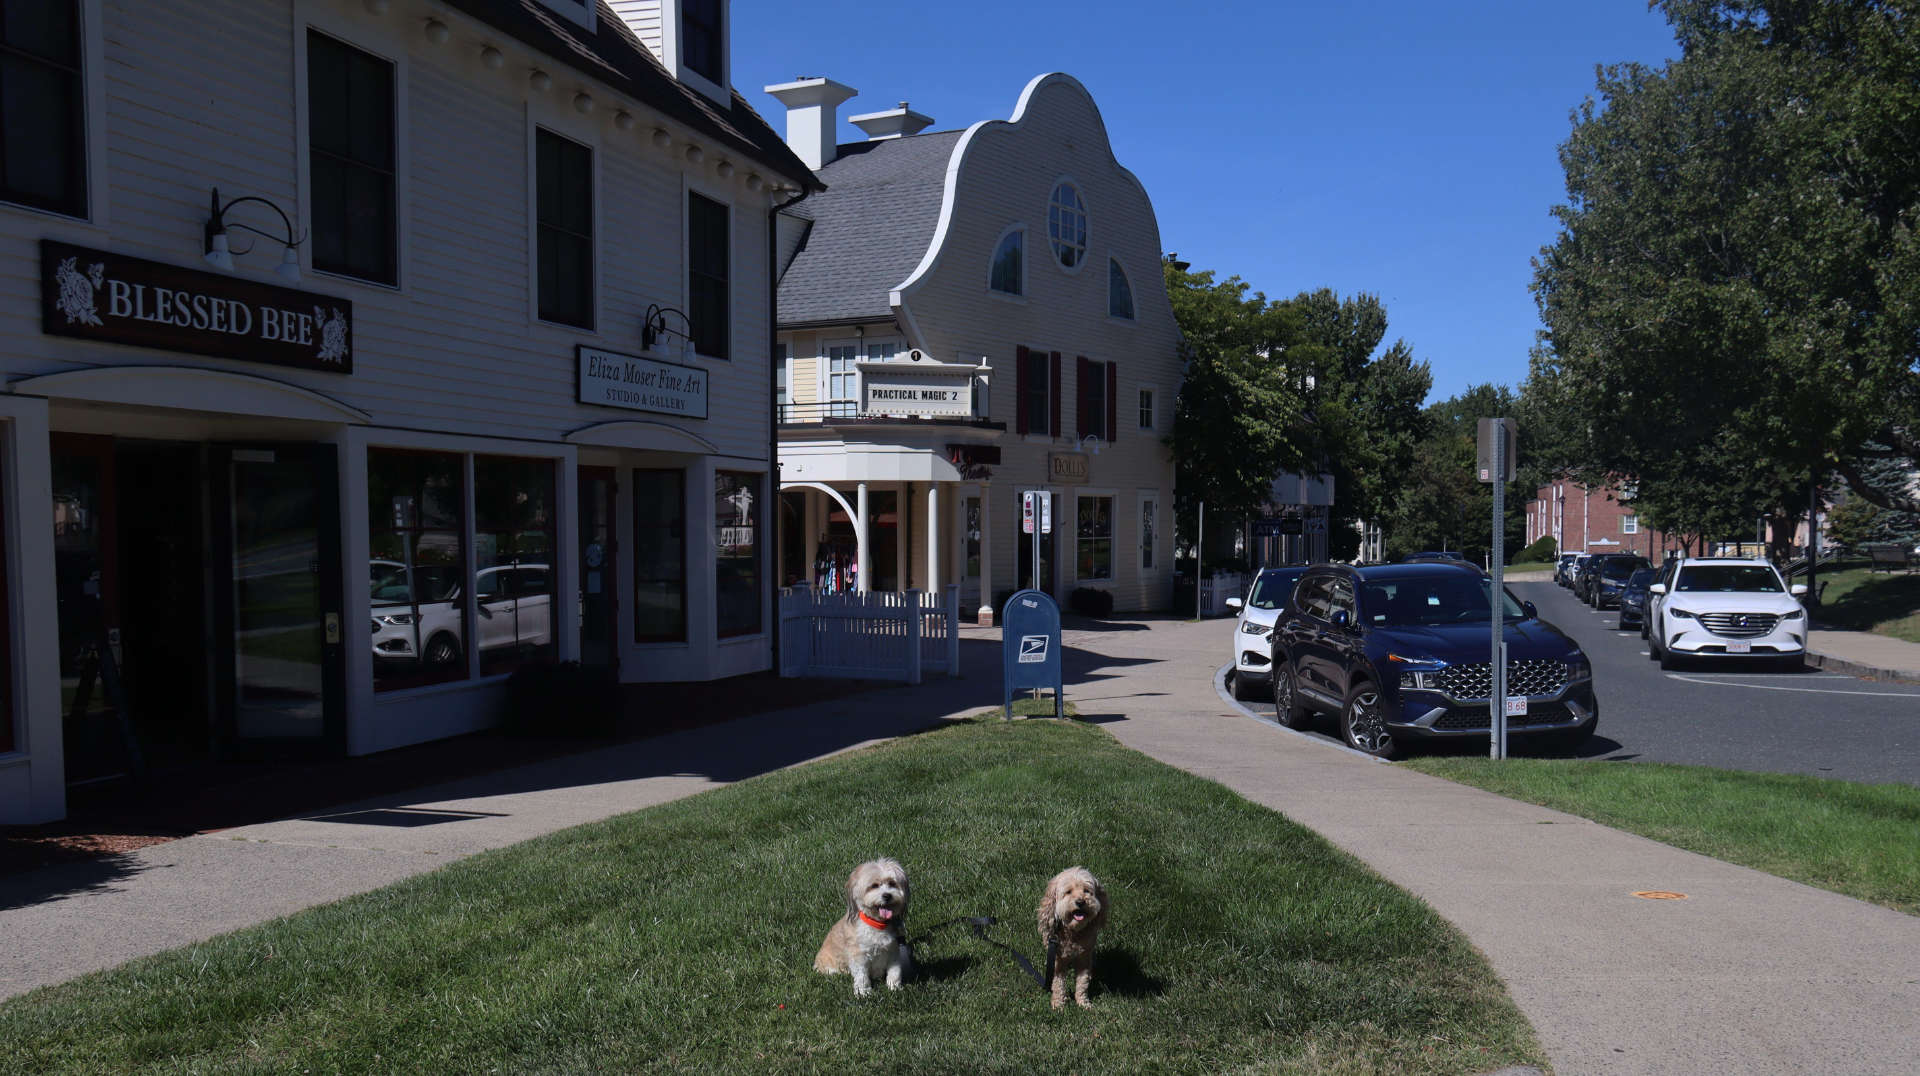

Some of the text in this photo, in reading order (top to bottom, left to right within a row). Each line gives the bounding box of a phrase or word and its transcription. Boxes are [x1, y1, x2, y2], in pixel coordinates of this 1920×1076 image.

[105, 279, 313, 346] BLESSED BEE
[587, 355, 701, 394] Eliza Moser Fine Art
[605, 388, 686, 411] STUDIO & GALLERY
[872, 389, 958, 401] PRACTICAL MAGIC 2
